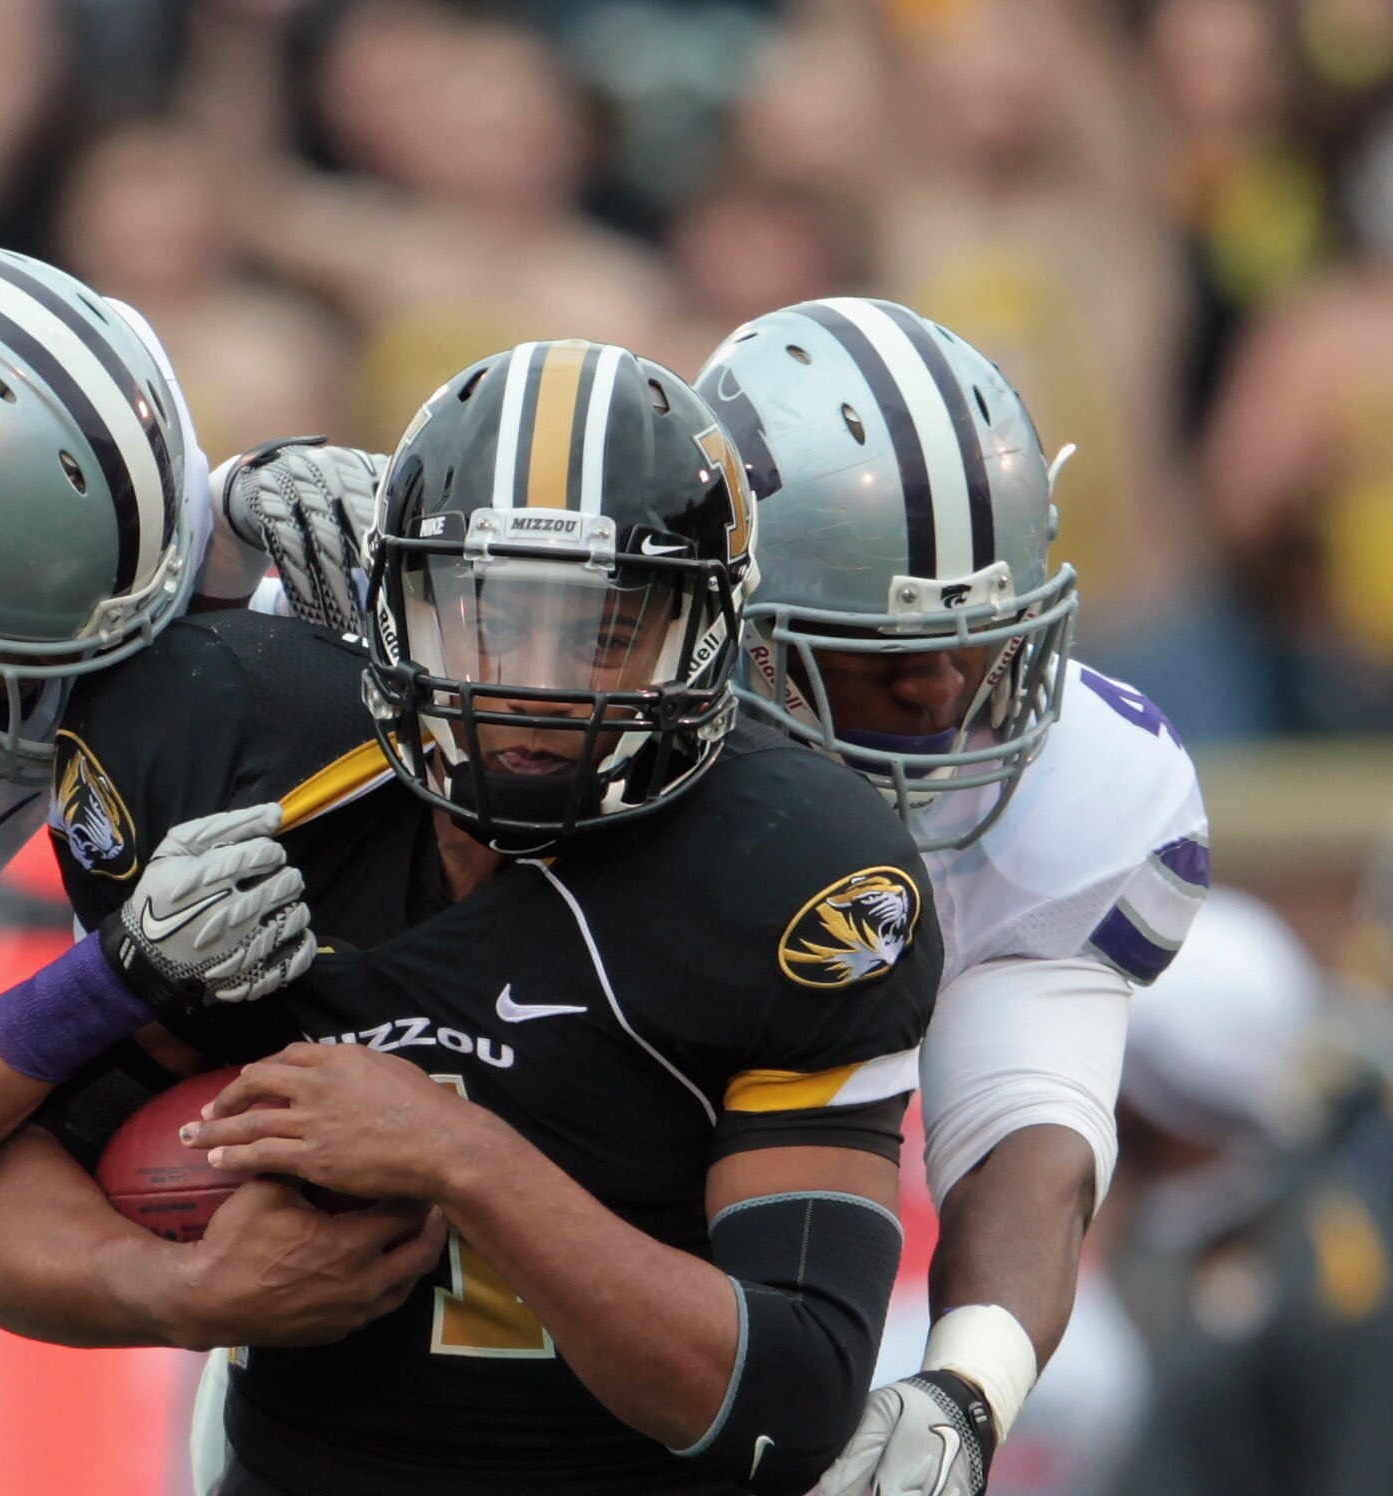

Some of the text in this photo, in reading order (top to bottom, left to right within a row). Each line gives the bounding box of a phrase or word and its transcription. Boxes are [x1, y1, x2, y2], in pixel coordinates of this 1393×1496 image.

[419, 516, 446, 537] NIKE
[511, 517, 576, 533] MIZZOU
[302, 1017, 514, 1069] ZZOU
